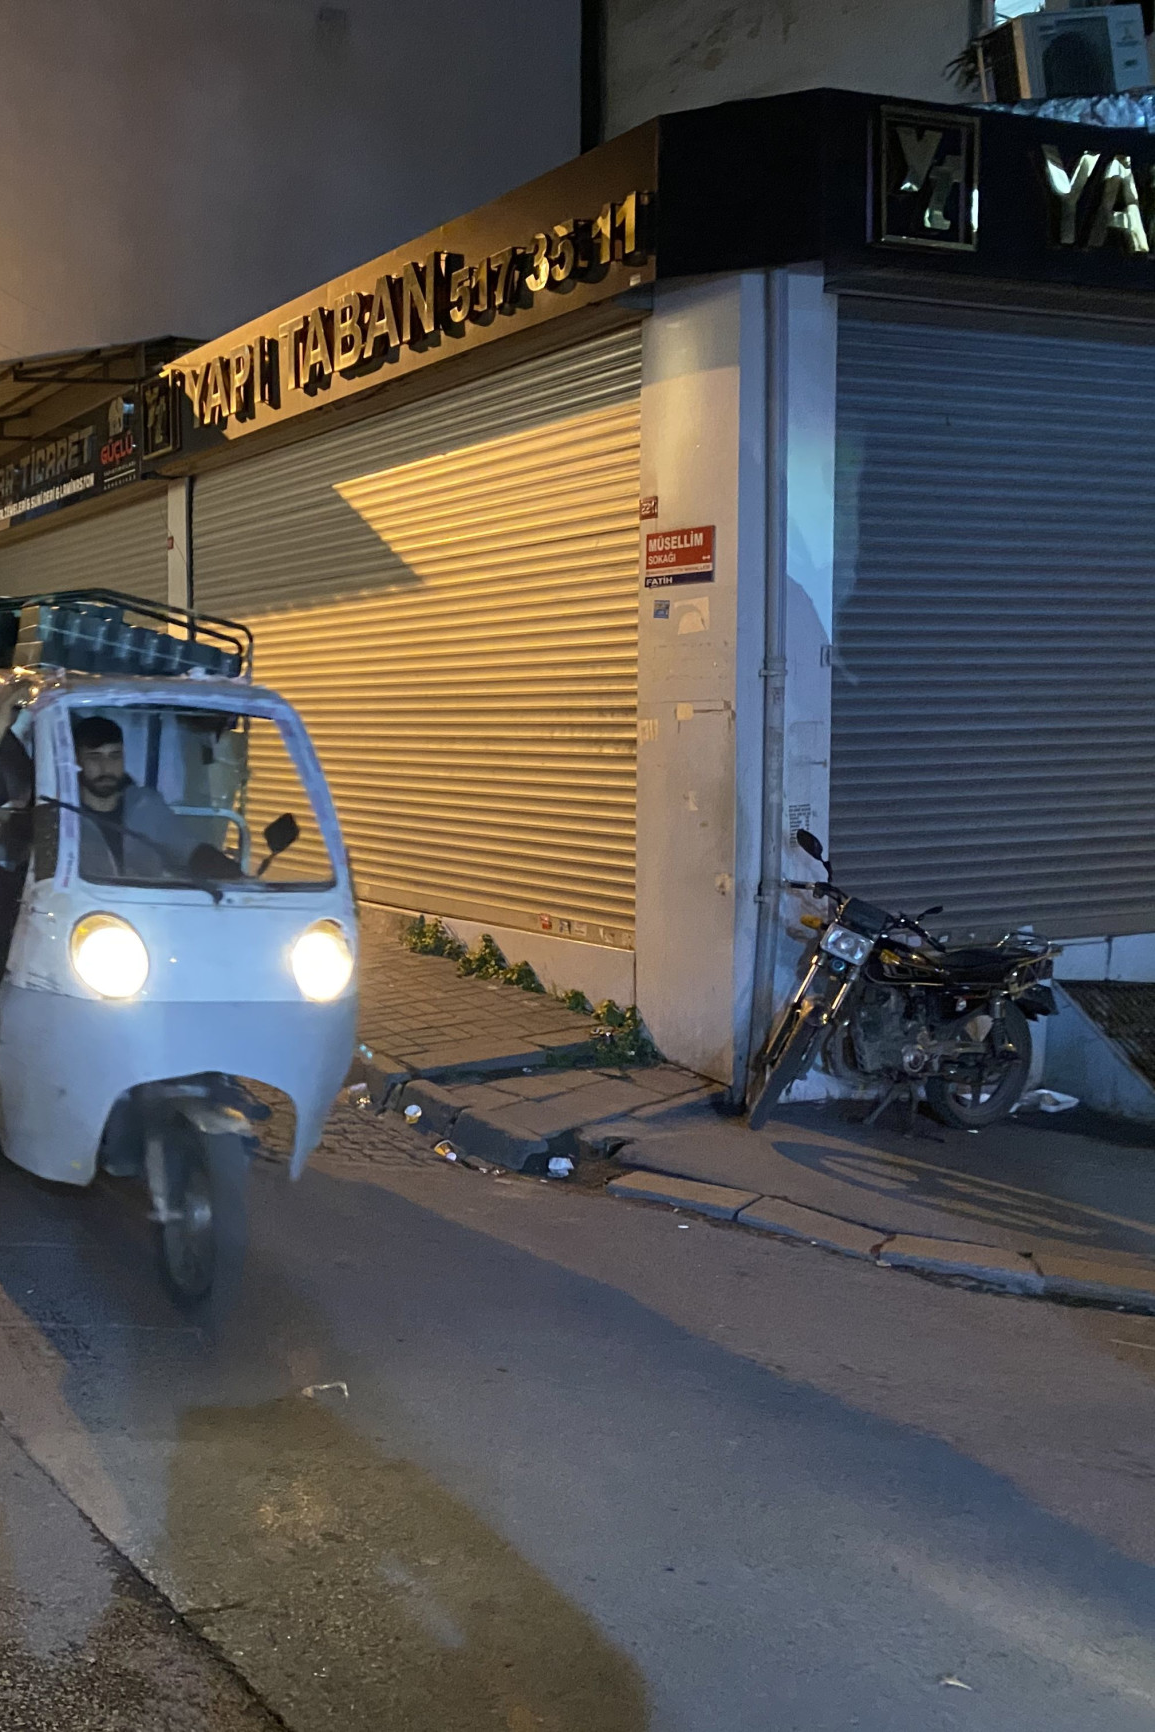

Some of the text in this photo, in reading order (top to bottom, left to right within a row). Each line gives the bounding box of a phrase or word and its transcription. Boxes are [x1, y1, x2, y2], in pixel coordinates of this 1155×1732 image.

[184, 191, 637, 428] YAPI TABAN 517 35 11
[100, 430, 134, 465] GÜÇLÜ
[648, 531, 704, 552] MÜSELLİM
[648, 552, 676, 565] SOKAĞI
[646, 576, 673, 586] FATİH
